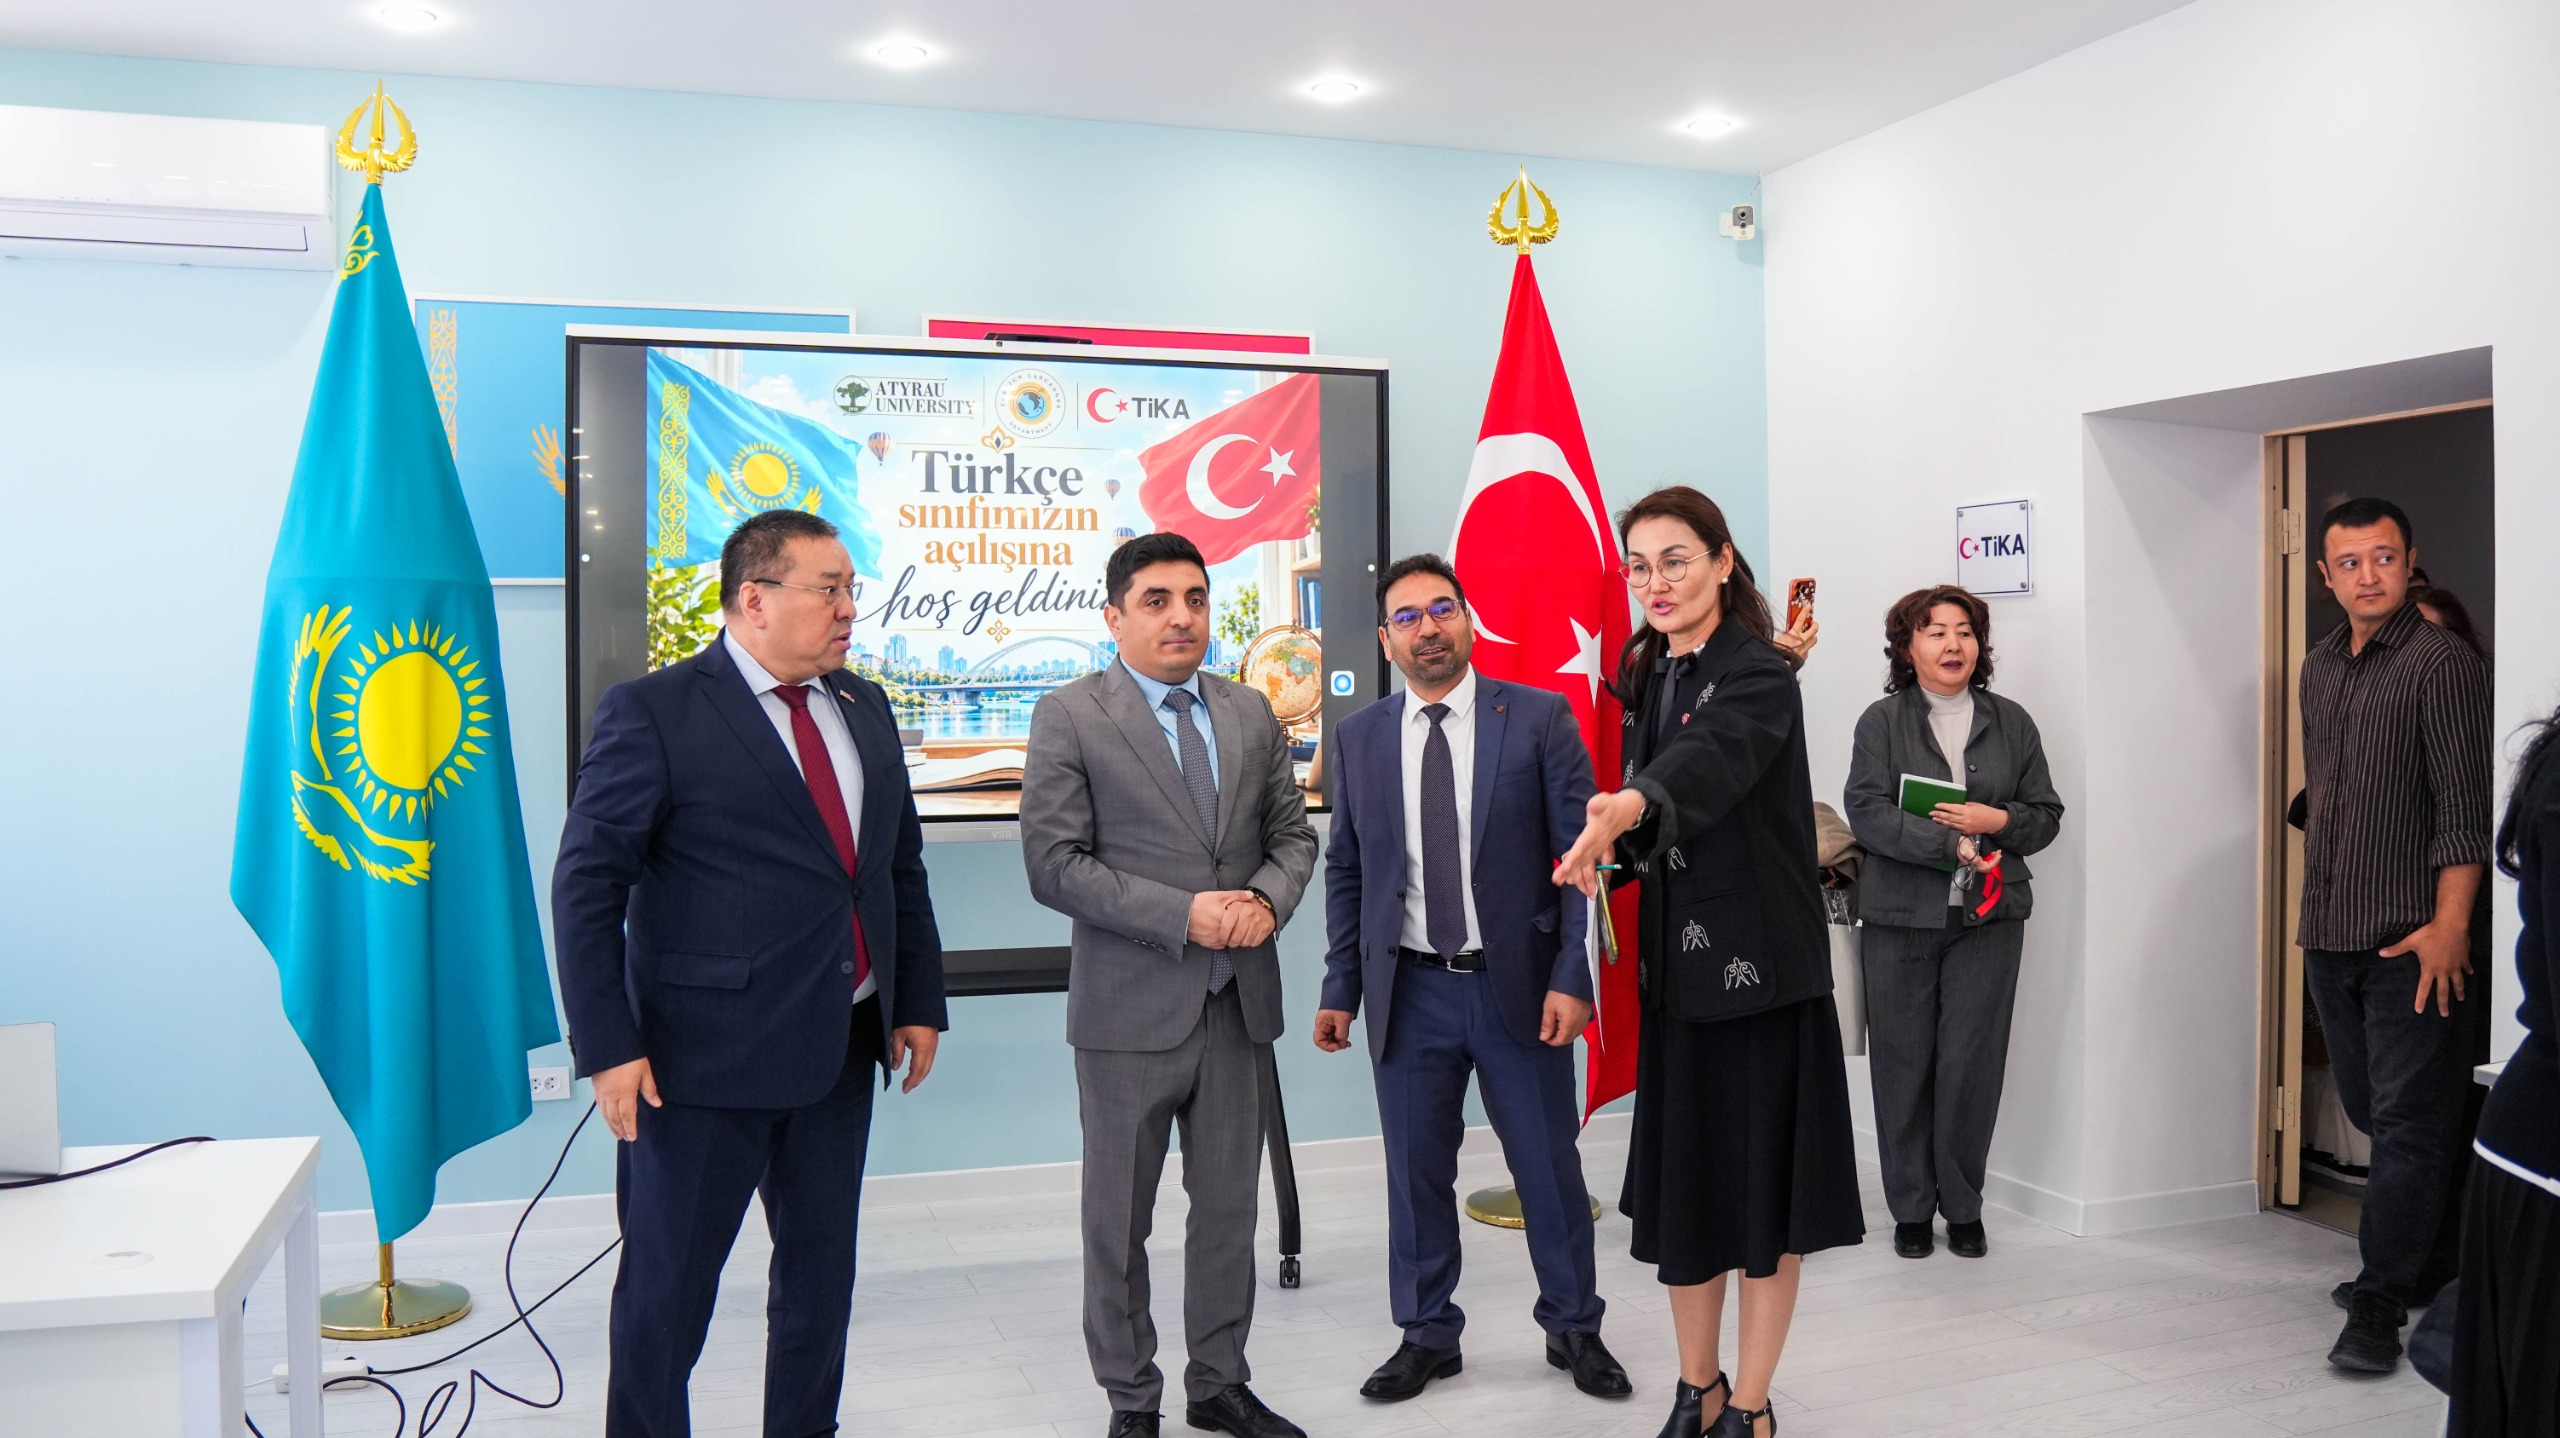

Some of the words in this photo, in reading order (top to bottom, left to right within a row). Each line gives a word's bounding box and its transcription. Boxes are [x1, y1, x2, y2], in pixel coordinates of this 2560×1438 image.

[875, 380, 946, 398] ATYRAU
[875, 398, 976, 415] UNIVERSITY
[911, 449, 1084, 506] Türkçe
[898, 494, 1100, 532] sınıfımızın
[924, 532, 1074, 573] açılışına
[860, 564, 962, 629] hoş
[962, 568, 1109, 636] geldini
